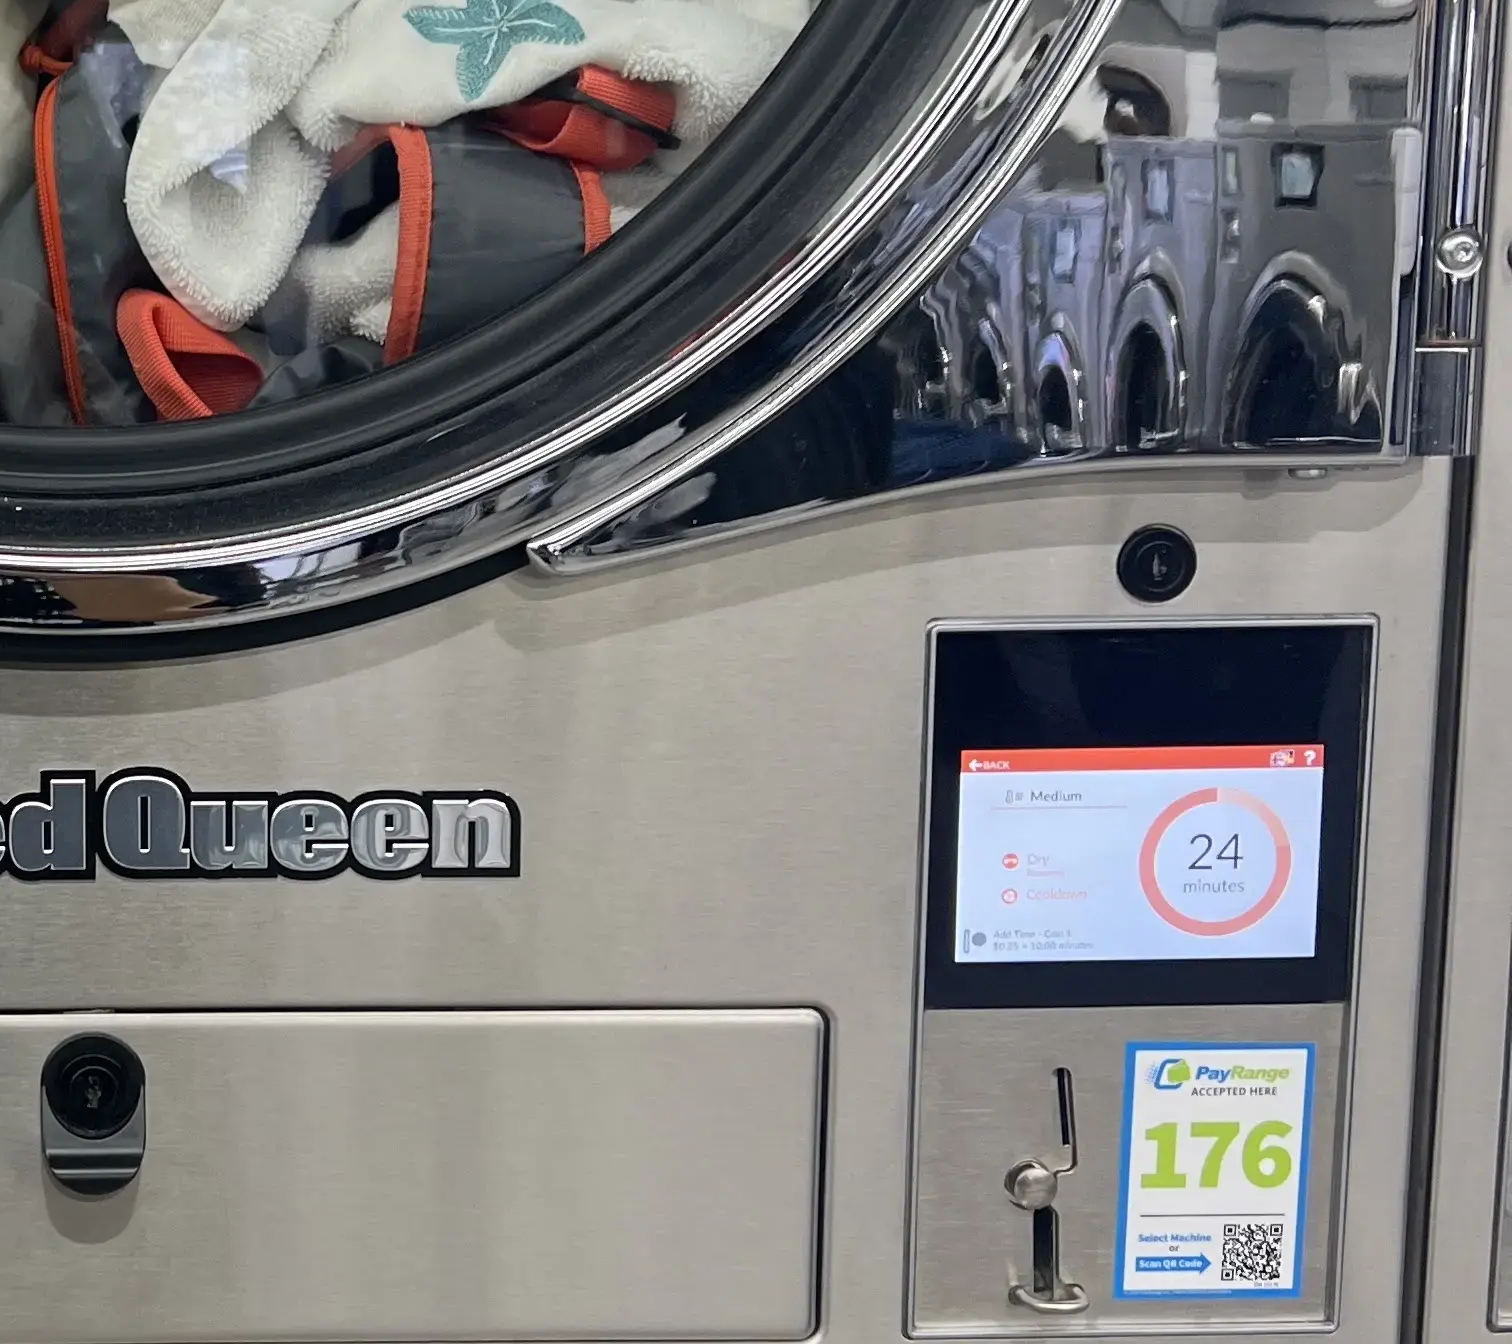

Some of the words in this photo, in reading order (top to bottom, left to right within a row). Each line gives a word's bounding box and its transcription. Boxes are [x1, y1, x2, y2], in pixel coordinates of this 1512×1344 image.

[983, 761, 1010, 770] BACK
[1030, 791, 1082, 802] Medium
[97, 766, 521, 878] Queen
[1188, 833, 1244, 870] 24
[1027, 854, 1050, 866] Dry
[1183, 879, 1245, 894] minutes
[1026, 889, 1087, 900] Cooldown
[993, 930, 1012, 938] Add
[1196, 1065, 1290, 1083] PayRange
[1191, 1087, 1246, 1096] ACCEPTED
[1249, 1087, 1277, 1096] HERE
[1140, 1120, 1293, 1189] 176
[1138, 1233, 1168, 1242] Select
[1171, 1233, 1211, 1242] Machine
[1169, 1244, 1180, 1252] or
[1139, 1259, 1161, 1268] Scan
[1179, 1258, 1202, 1268] Code
